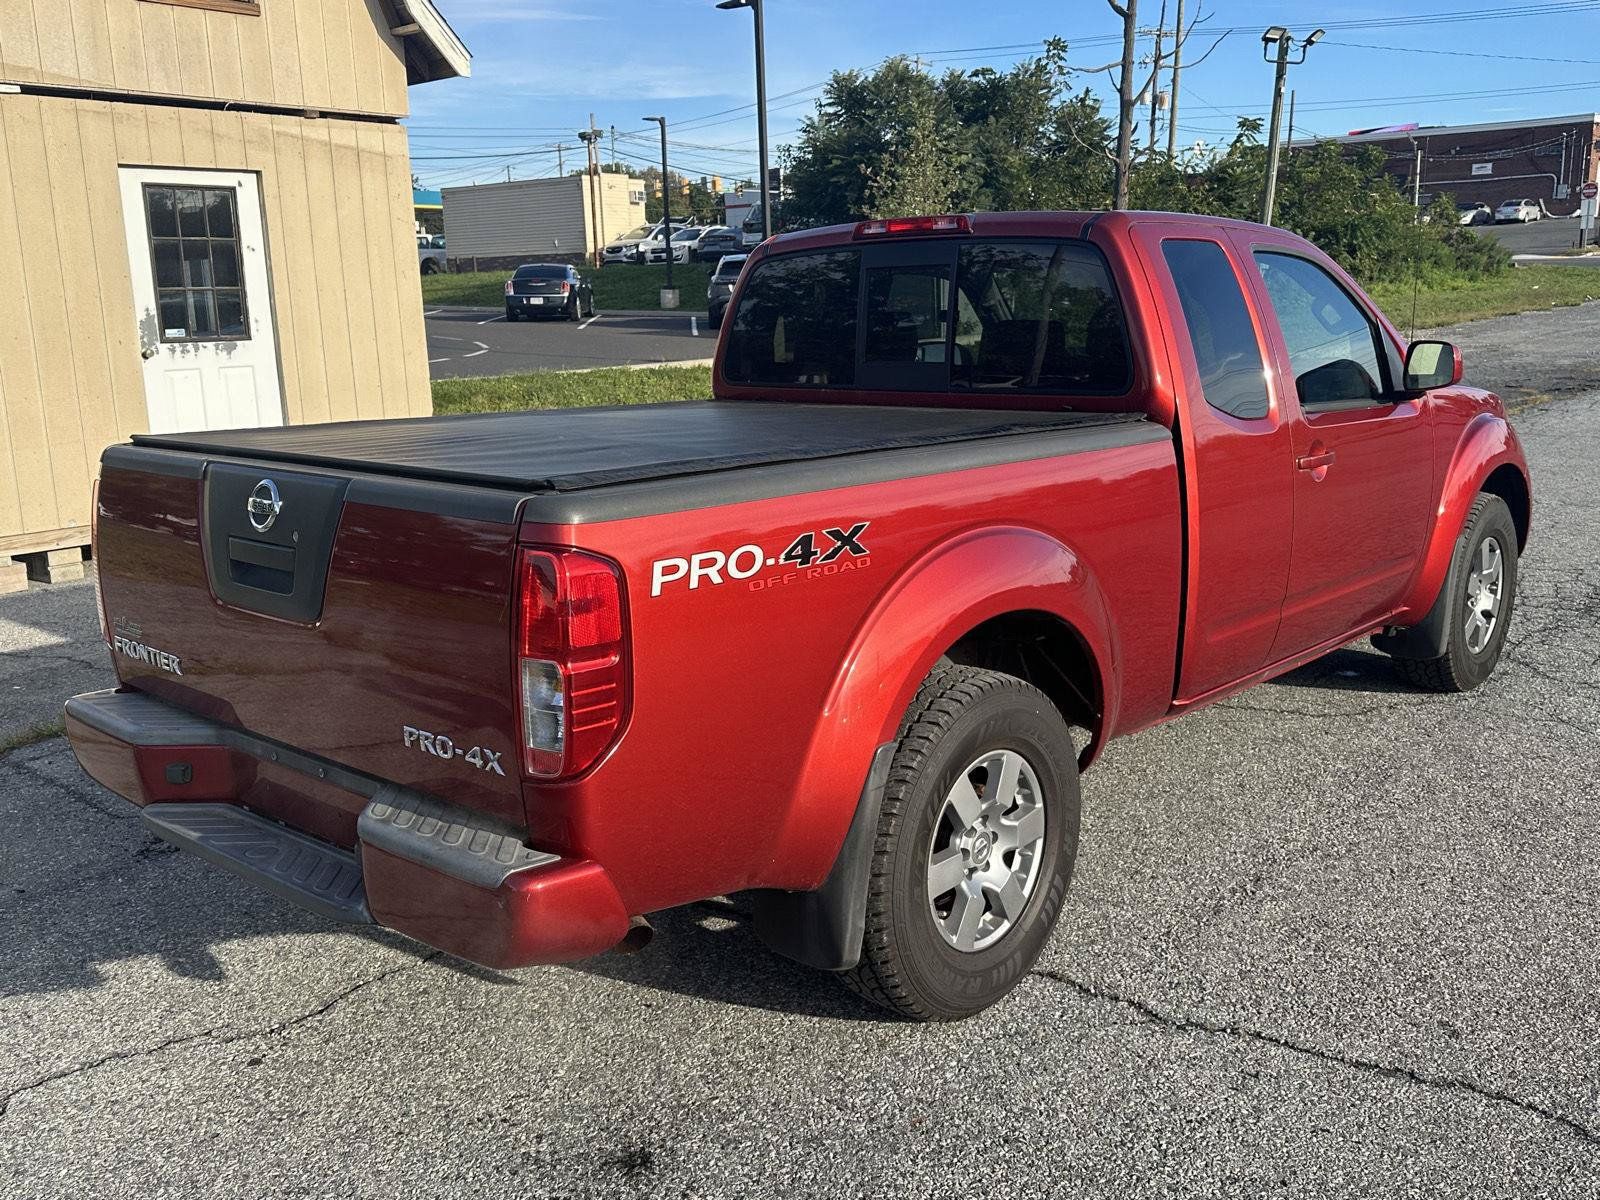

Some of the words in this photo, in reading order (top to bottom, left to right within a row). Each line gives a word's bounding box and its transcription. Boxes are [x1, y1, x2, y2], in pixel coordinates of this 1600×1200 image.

[749, 573, 797, 592] OFF
[807, 557, 871, 579] ROAD
[114, 635, 183, 675] FRONTIER
[403, 725, 506, 777] PRO-4X
